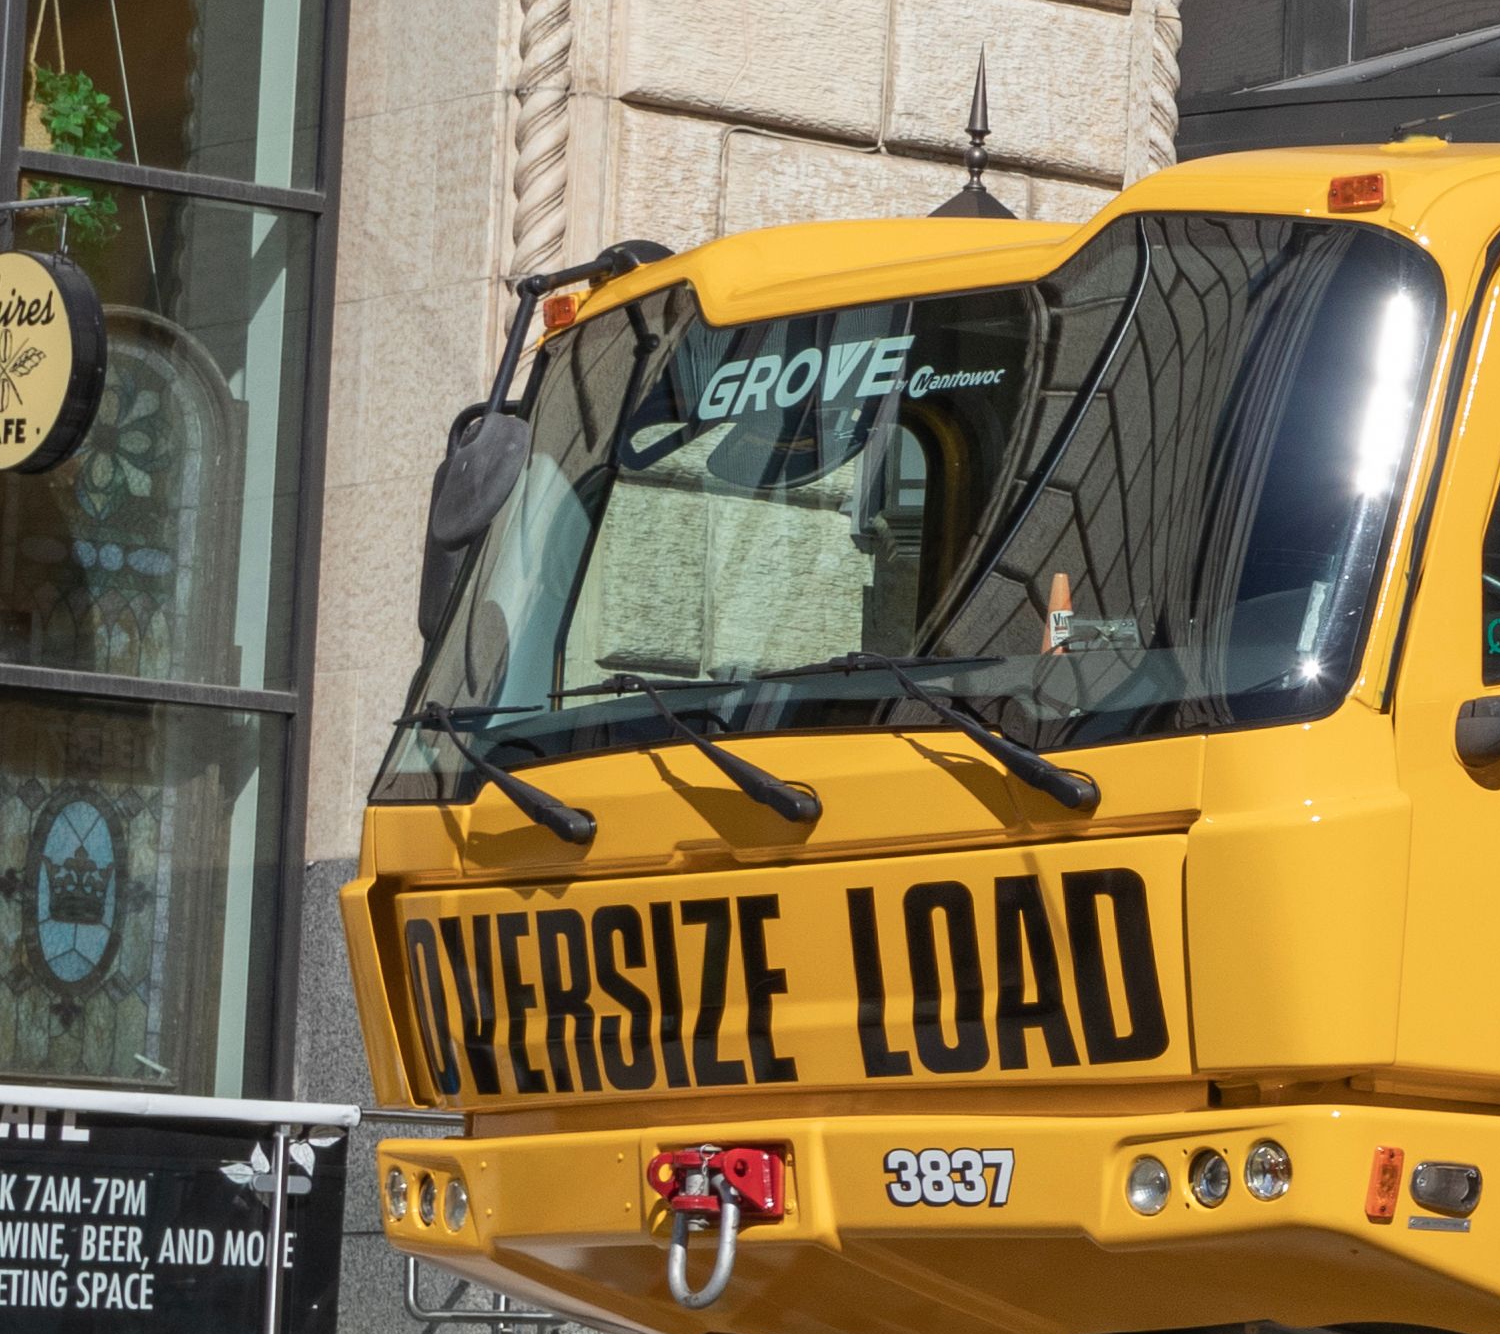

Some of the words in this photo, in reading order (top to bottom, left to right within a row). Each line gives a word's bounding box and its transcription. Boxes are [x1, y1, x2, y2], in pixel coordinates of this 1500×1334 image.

[0, 288, 55, 327] ires
[698, 335, 916, 420] GROVE
[908, 365, 1006, 399] Manitowoc
[0, 418, 27, 444] FE
[406, 893, 799, 1097] OVERSIZE
[846, 867, 1170, 1079] LOAD
[24, 1174, 147, 1216] 7AM-7PM
[884, 1147, 1016, 1207] 3837
[0, 1221, 70, 1268] WINE,
[81, 1225, 150, 1270] BEER,
[158, 1227, 215, 1266] AND
[223, 1230, 297, 1269] MOE
[76, 1272, 155, 1311] SPACE
